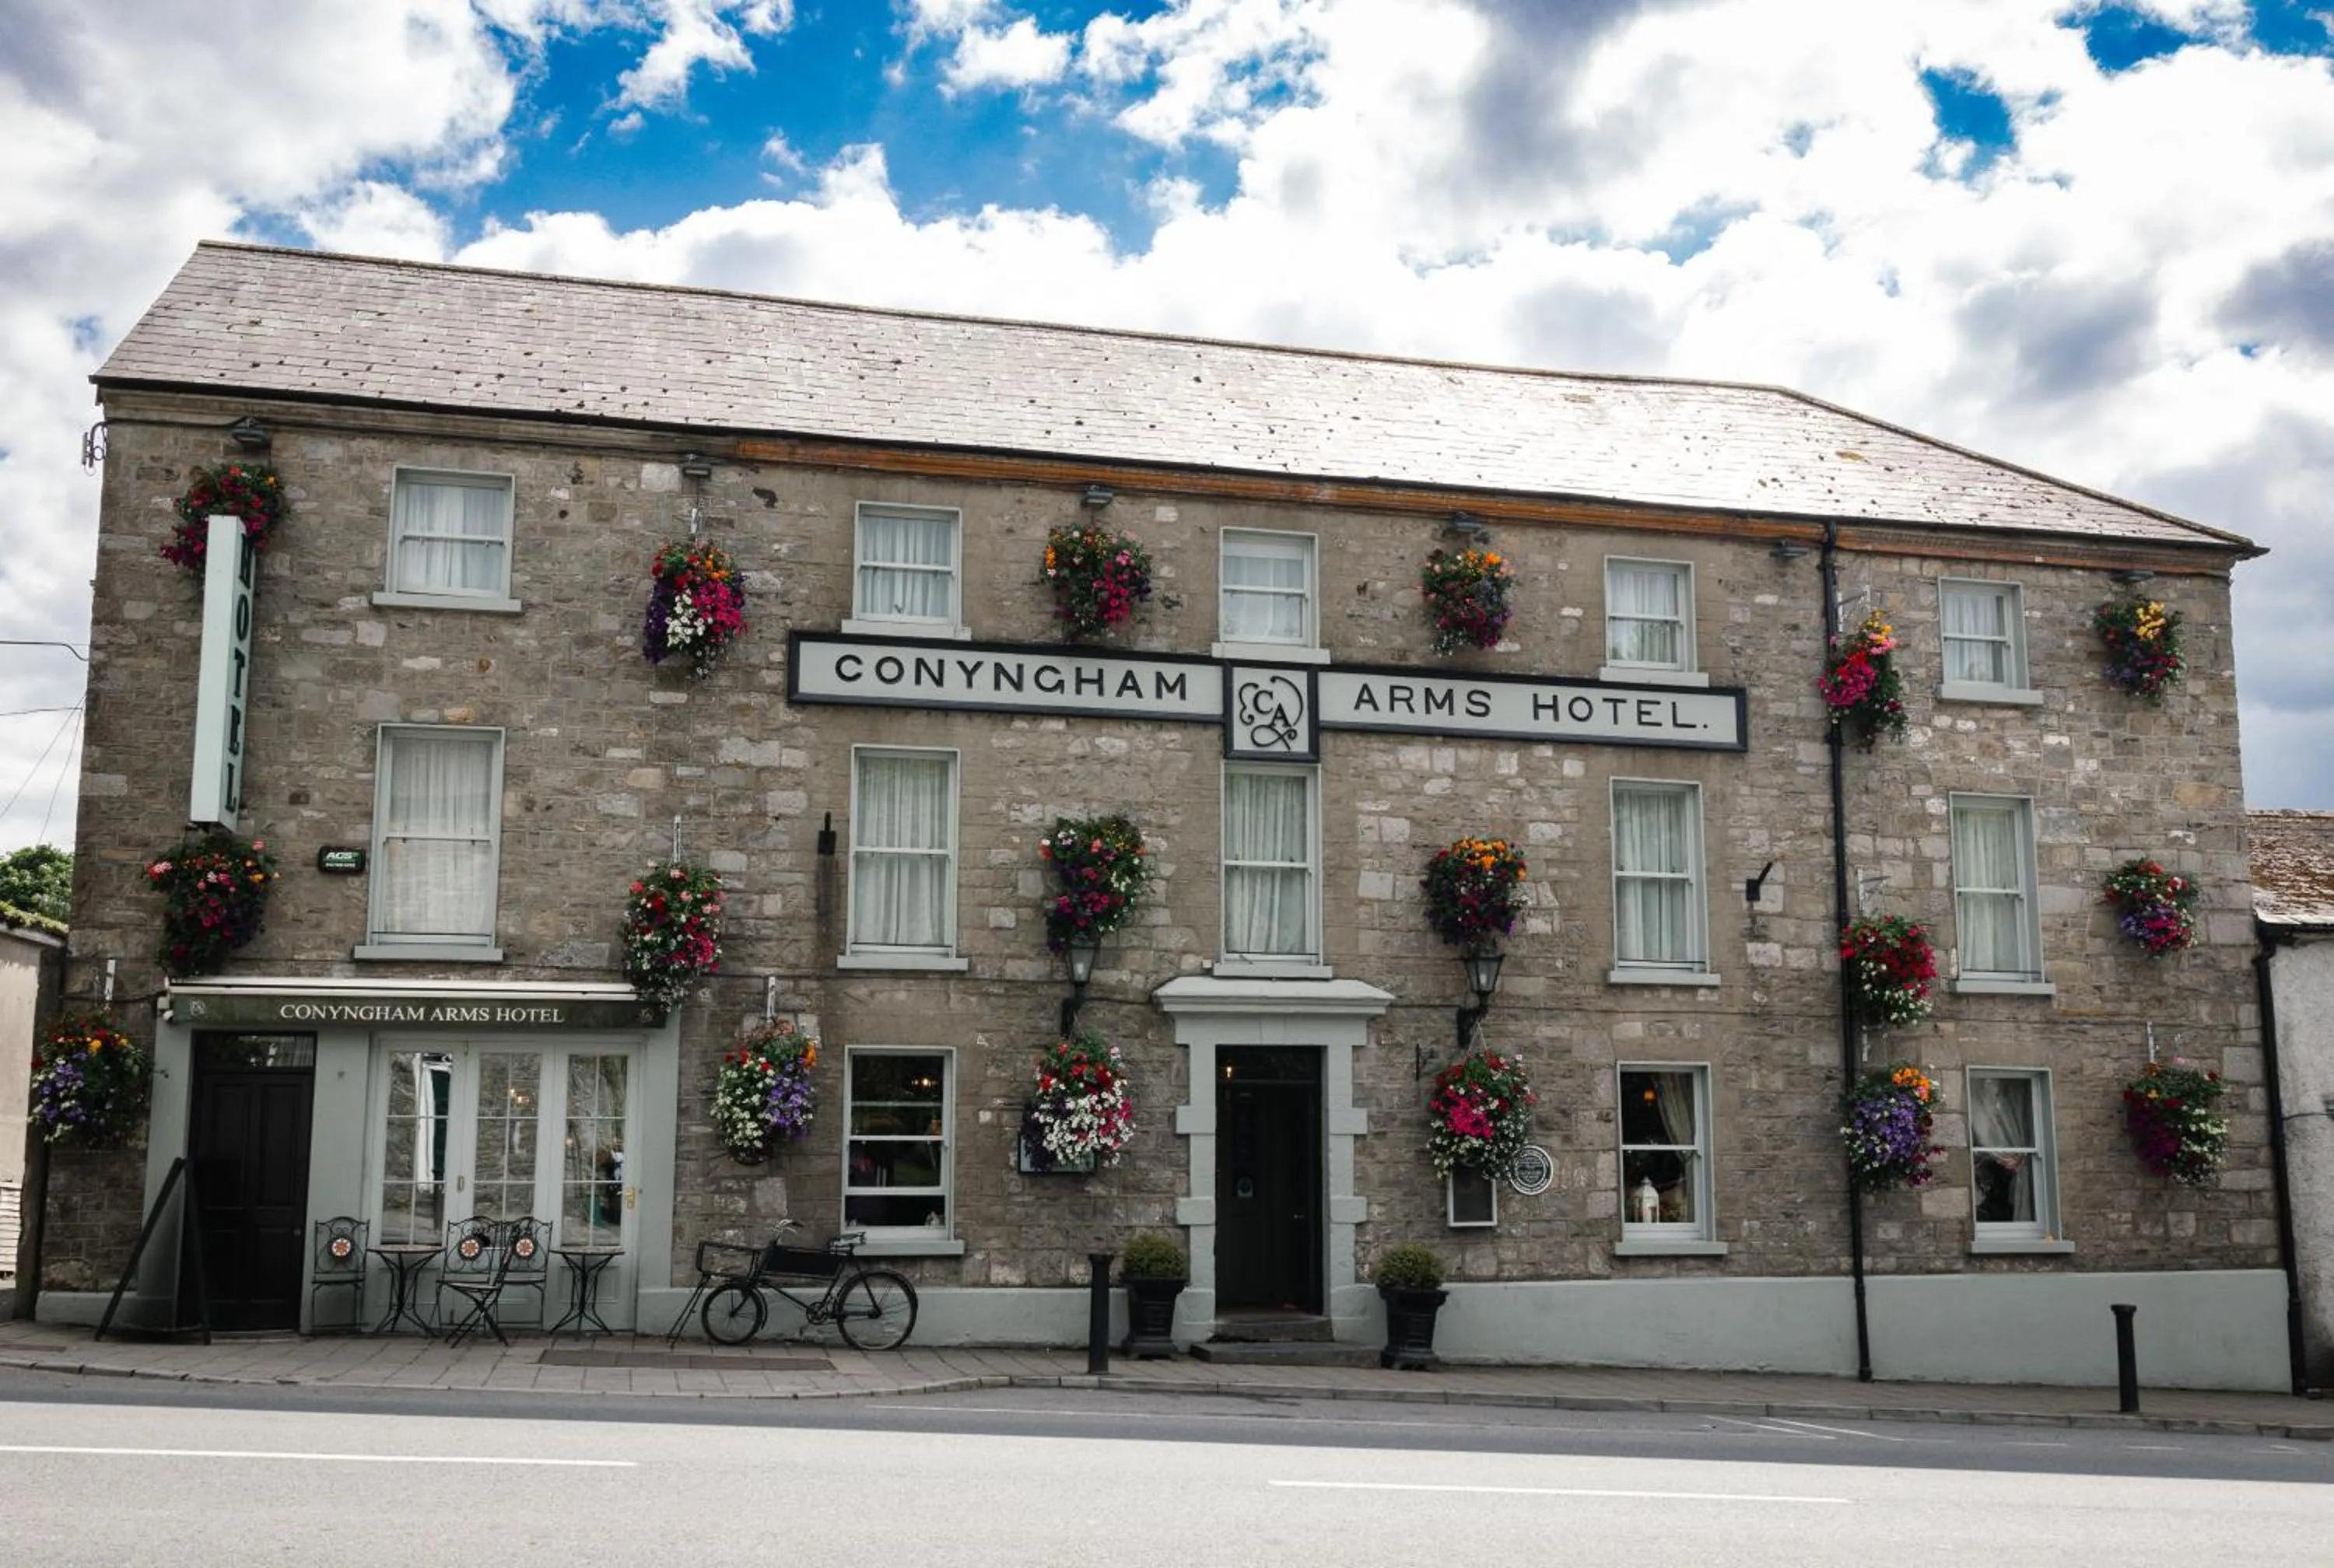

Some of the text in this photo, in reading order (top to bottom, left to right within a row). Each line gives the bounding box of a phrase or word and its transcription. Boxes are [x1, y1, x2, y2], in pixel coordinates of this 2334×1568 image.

[225, 532, 251, 813] HOTEL
[834, 653, 1187, 701] CONYNGHAM
[1353, 682, 1708, 730] ARMS HOTEL.
[280, 1004, 565, 1023] CONYNGHAM ARMS HOTEL
